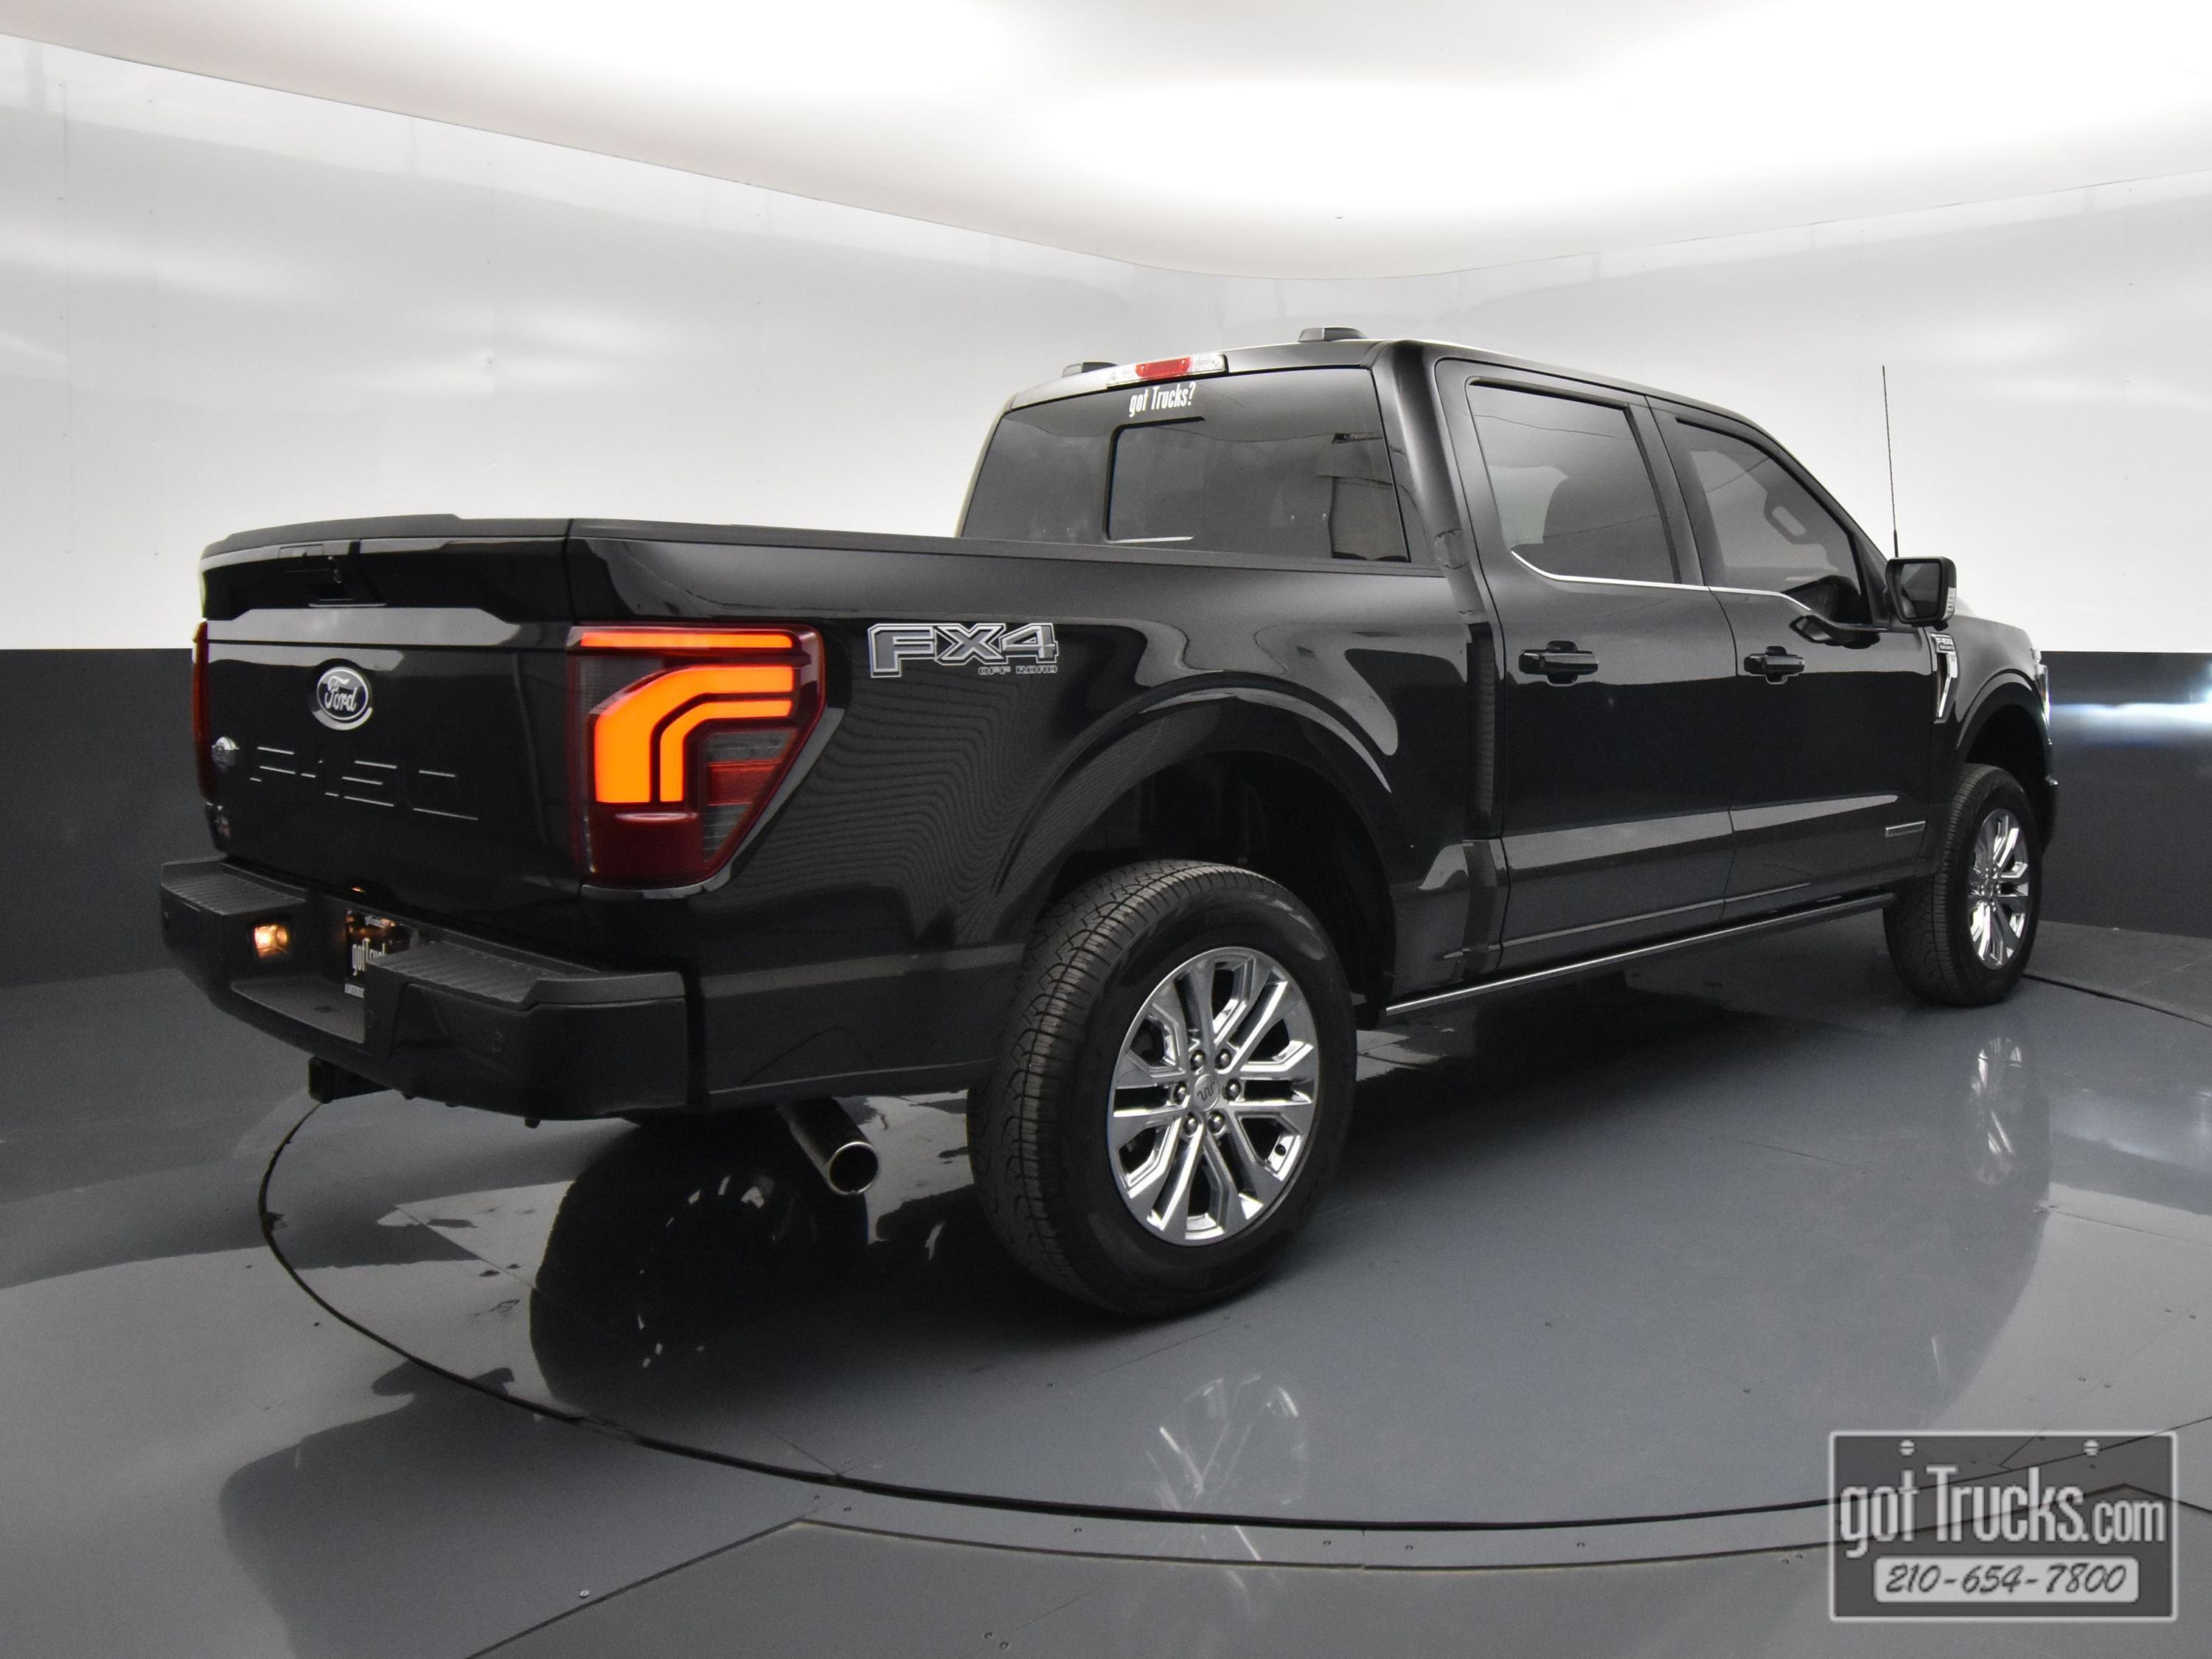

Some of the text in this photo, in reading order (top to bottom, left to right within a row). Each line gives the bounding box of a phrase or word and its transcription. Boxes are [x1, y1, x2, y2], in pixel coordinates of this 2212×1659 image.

[1129, 381, 1196, 418] got Trucks?
[867, 623, 1059, 678] FX4
[978, 666, 1057, 675] OFF ROAD
[324, 674, 358, 712] Ford
